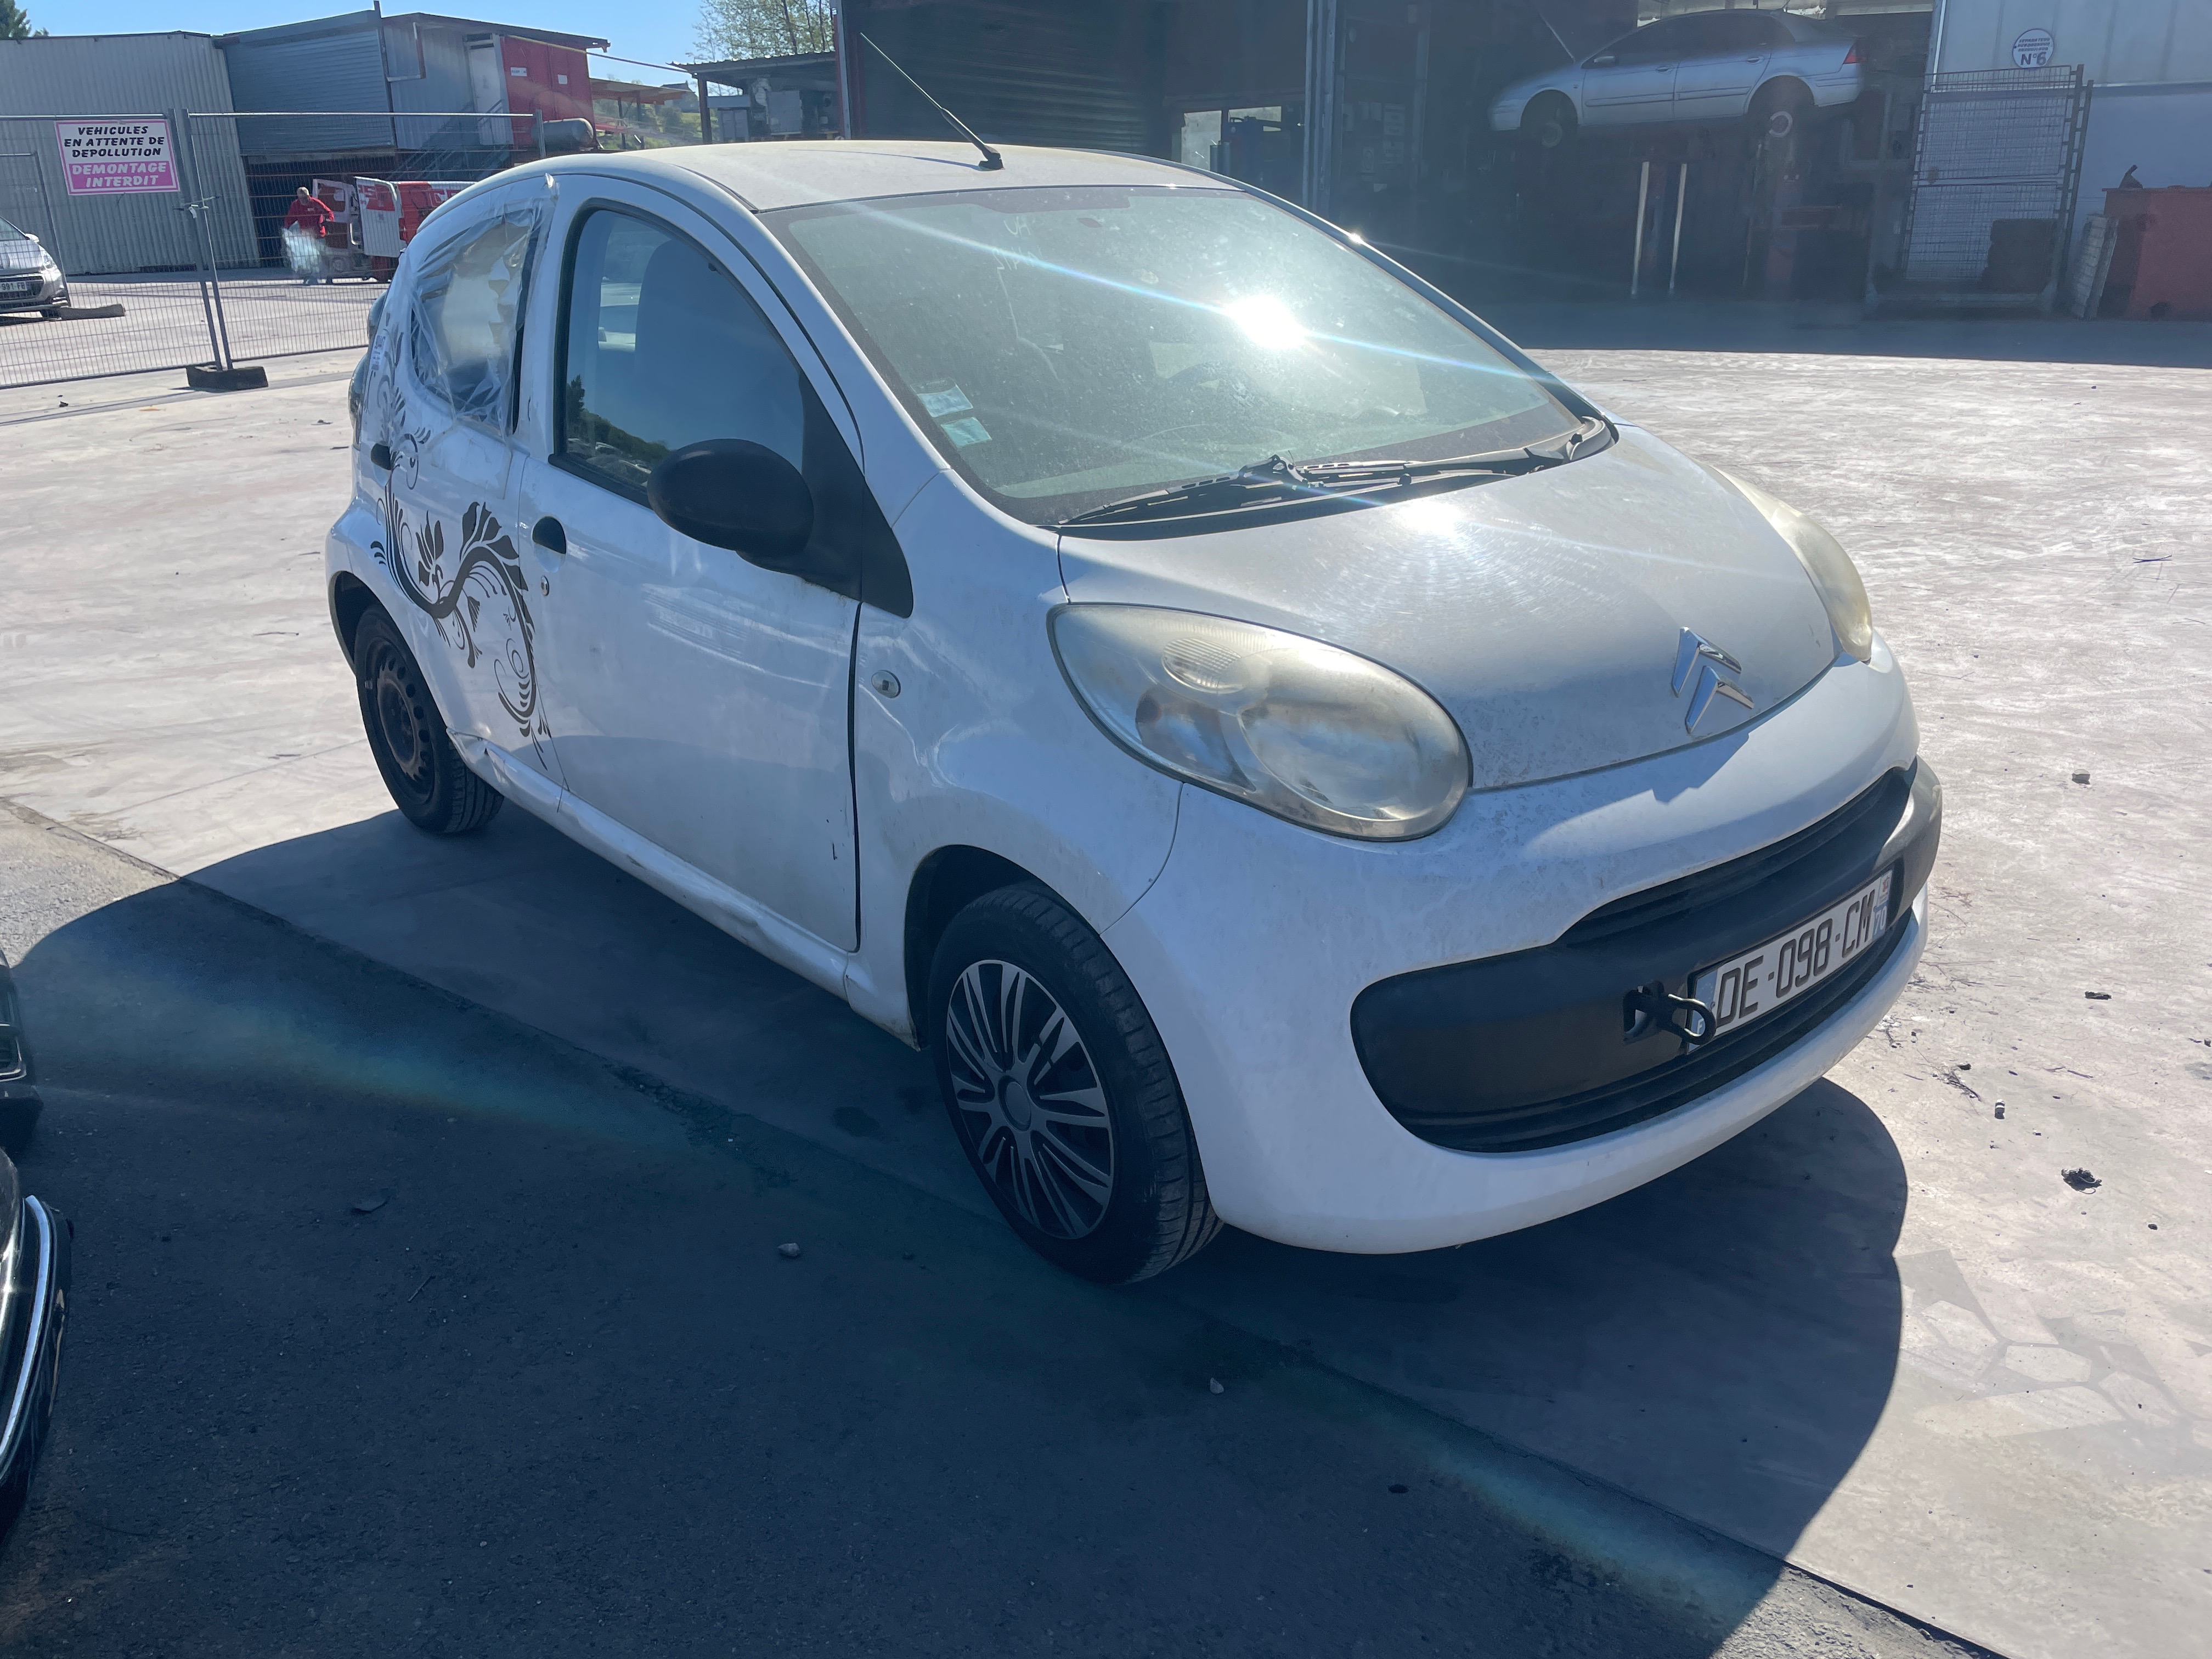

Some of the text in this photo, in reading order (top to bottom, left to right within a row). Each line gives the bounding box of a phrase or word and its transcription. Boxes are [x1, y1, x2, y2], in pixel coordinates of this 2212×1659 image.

[2020, 52, 2047, 65] N°6
[77, 126, 149, 135] VEHICULES
[64, 137, 165, 147] EN ATTENTE DE
[72, 148, 161, 157] DEPOLLUTION
[72, 162, 167, 175] DEMONTAGE
[86, 175, 159, 188] INTERDIT
[1874, 906, 1887, 935] 70
